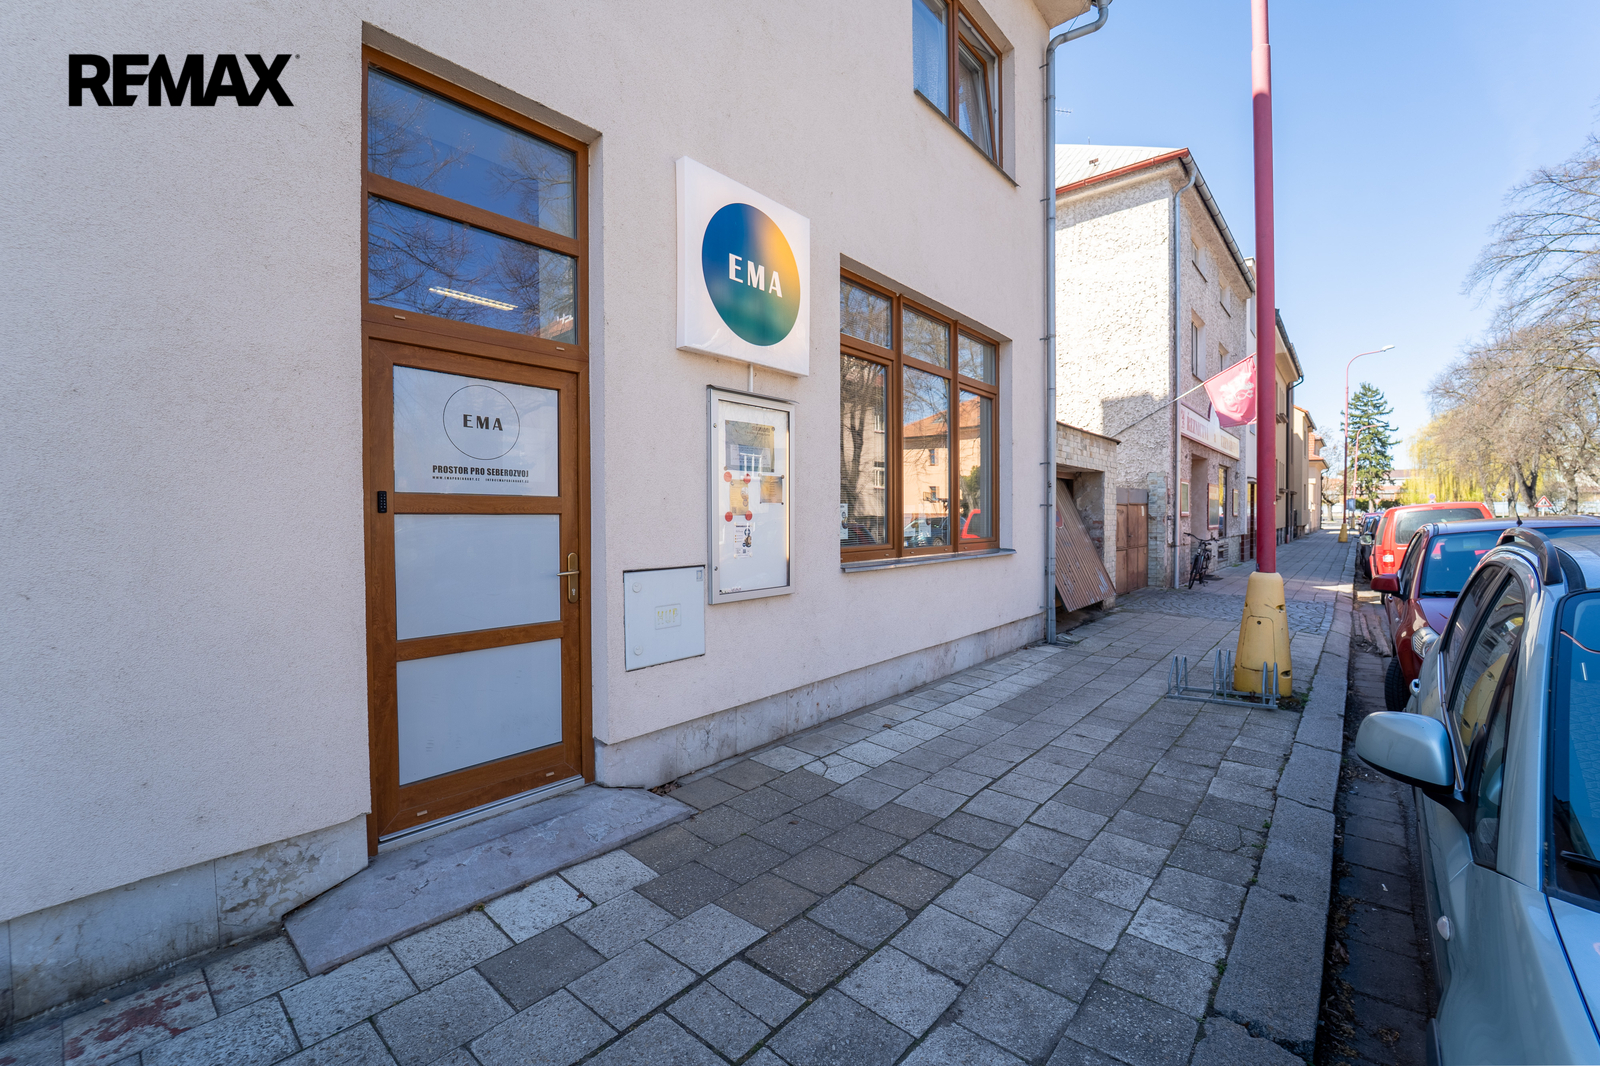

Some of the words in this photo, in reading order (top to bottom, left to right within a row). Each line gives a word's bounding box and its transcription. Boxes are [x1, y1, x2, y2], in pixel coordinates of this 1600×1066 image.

[729, 252, 783, 298] EMA
[463, 413, 503, 431] EMA
[432, 465, 468, 475] PROSTOR
[470, 467, 485, 475] PRO
[487, 468, 529, 477] SEBEROZVOJ
[657, 608, 678, 625] HUP
